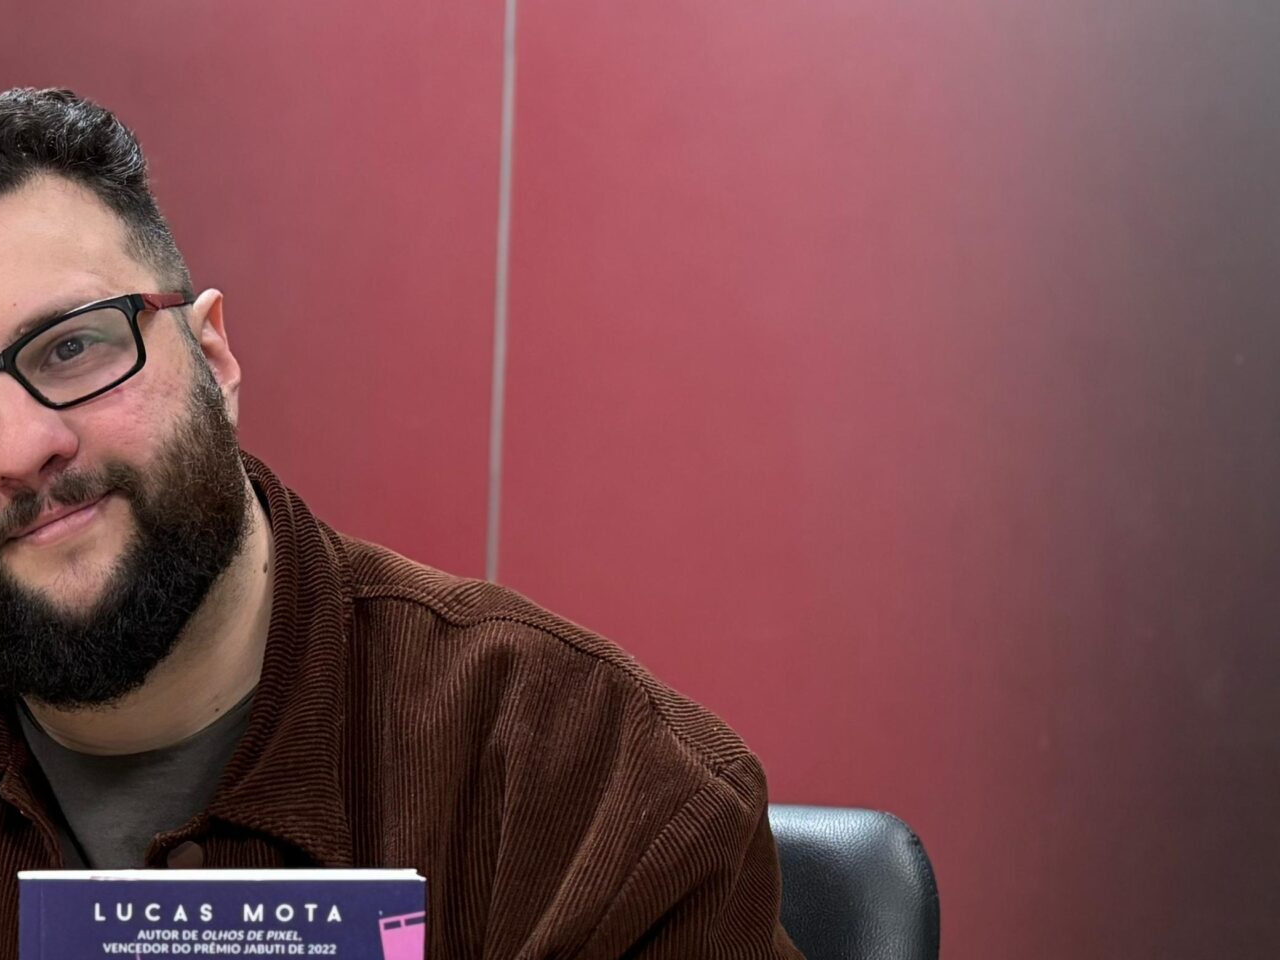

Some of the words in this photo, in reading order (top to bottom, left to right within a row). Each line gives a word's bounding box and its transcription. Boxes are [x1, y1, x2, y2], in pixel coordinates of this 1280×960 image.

[93, 902, 213, 922] LUCAS
[242, 903, 342, 922] MOTA
[137, 929, 179, 941] AUTOR
[182, 929, 199, 941] DE
[201, 929, 244, 941] OLHOS
[247, 930, 265, 941] DE
[103, 942, 170, 954] VENCEDOR
[171, 943, 191, 954] DO
[243, 943, 284, 955] JABUTI
[288, 944, 304, 955] DE
[307, 944, 337, 955] 2022
